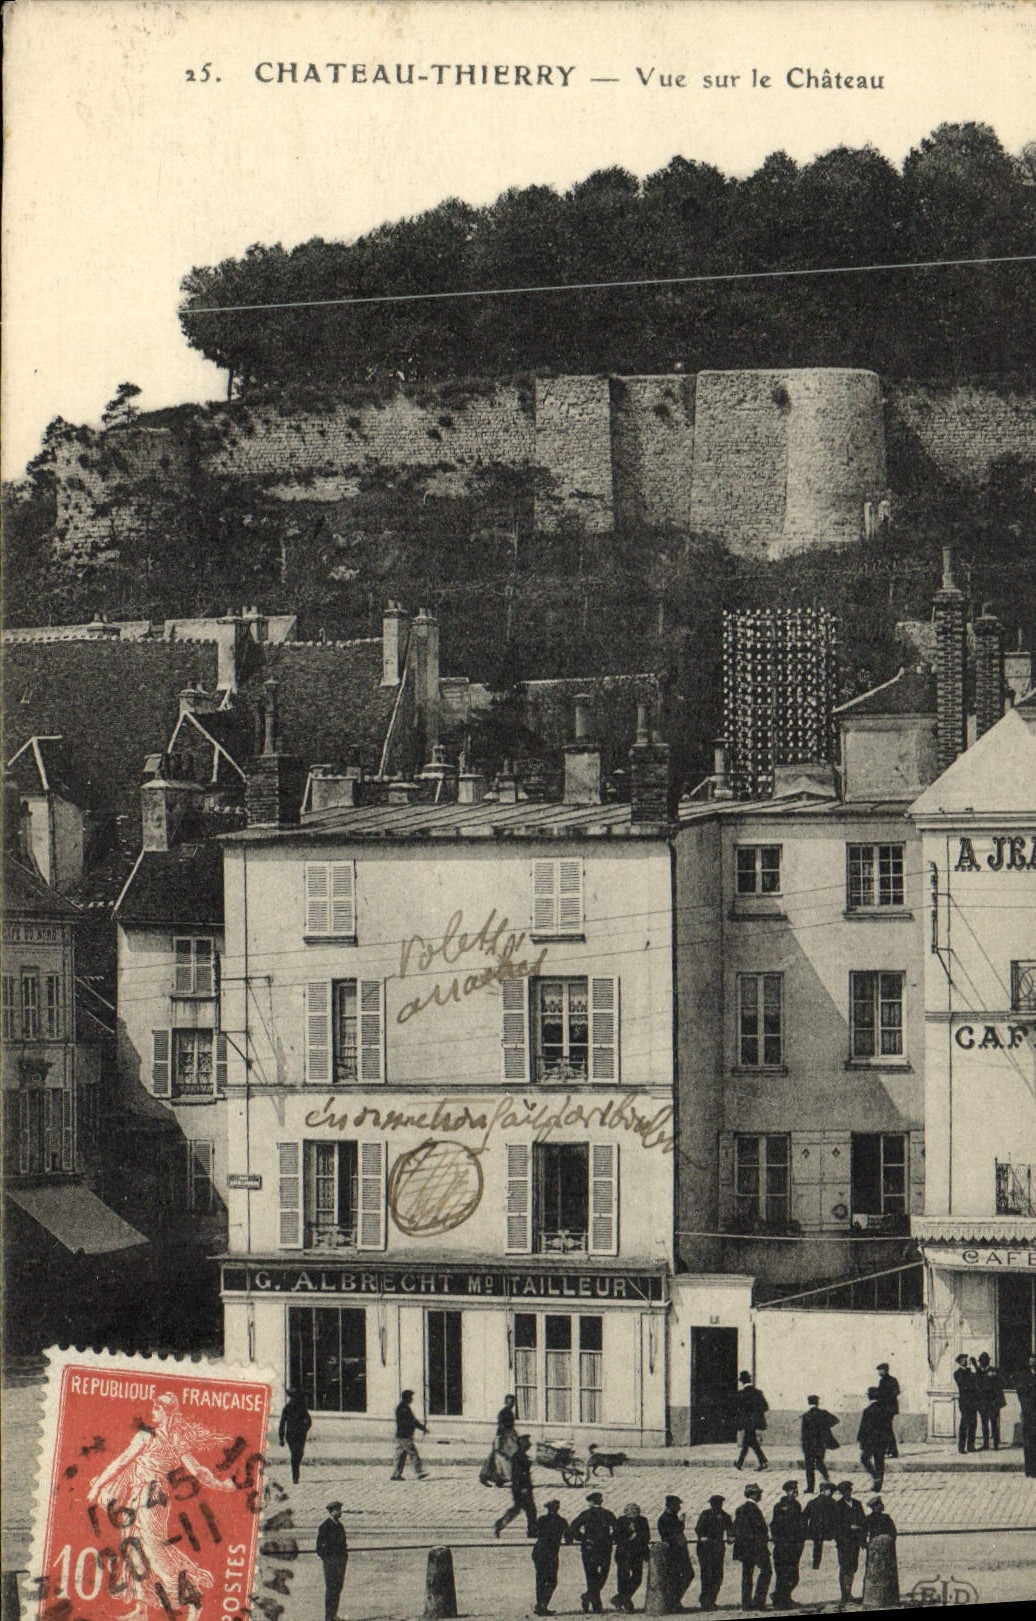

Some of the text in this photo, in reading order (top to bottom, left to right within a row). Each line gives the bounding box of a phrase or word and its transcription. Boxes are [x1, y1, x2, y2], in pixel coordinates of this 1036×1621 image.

[954, 836, 981, 872] A
[954, 1025, 1036, 1050] CAF
[255, 1271, 281, 1291] G.
[291, 1271, 454, 1293] ALBRECHT
[509, 1275, 626, 1297] TAILLEUR
[71, 1375, 262, 1412] REPUBLIQUE FRANÇAISE
[53, 1544, 104, 1600] 10
